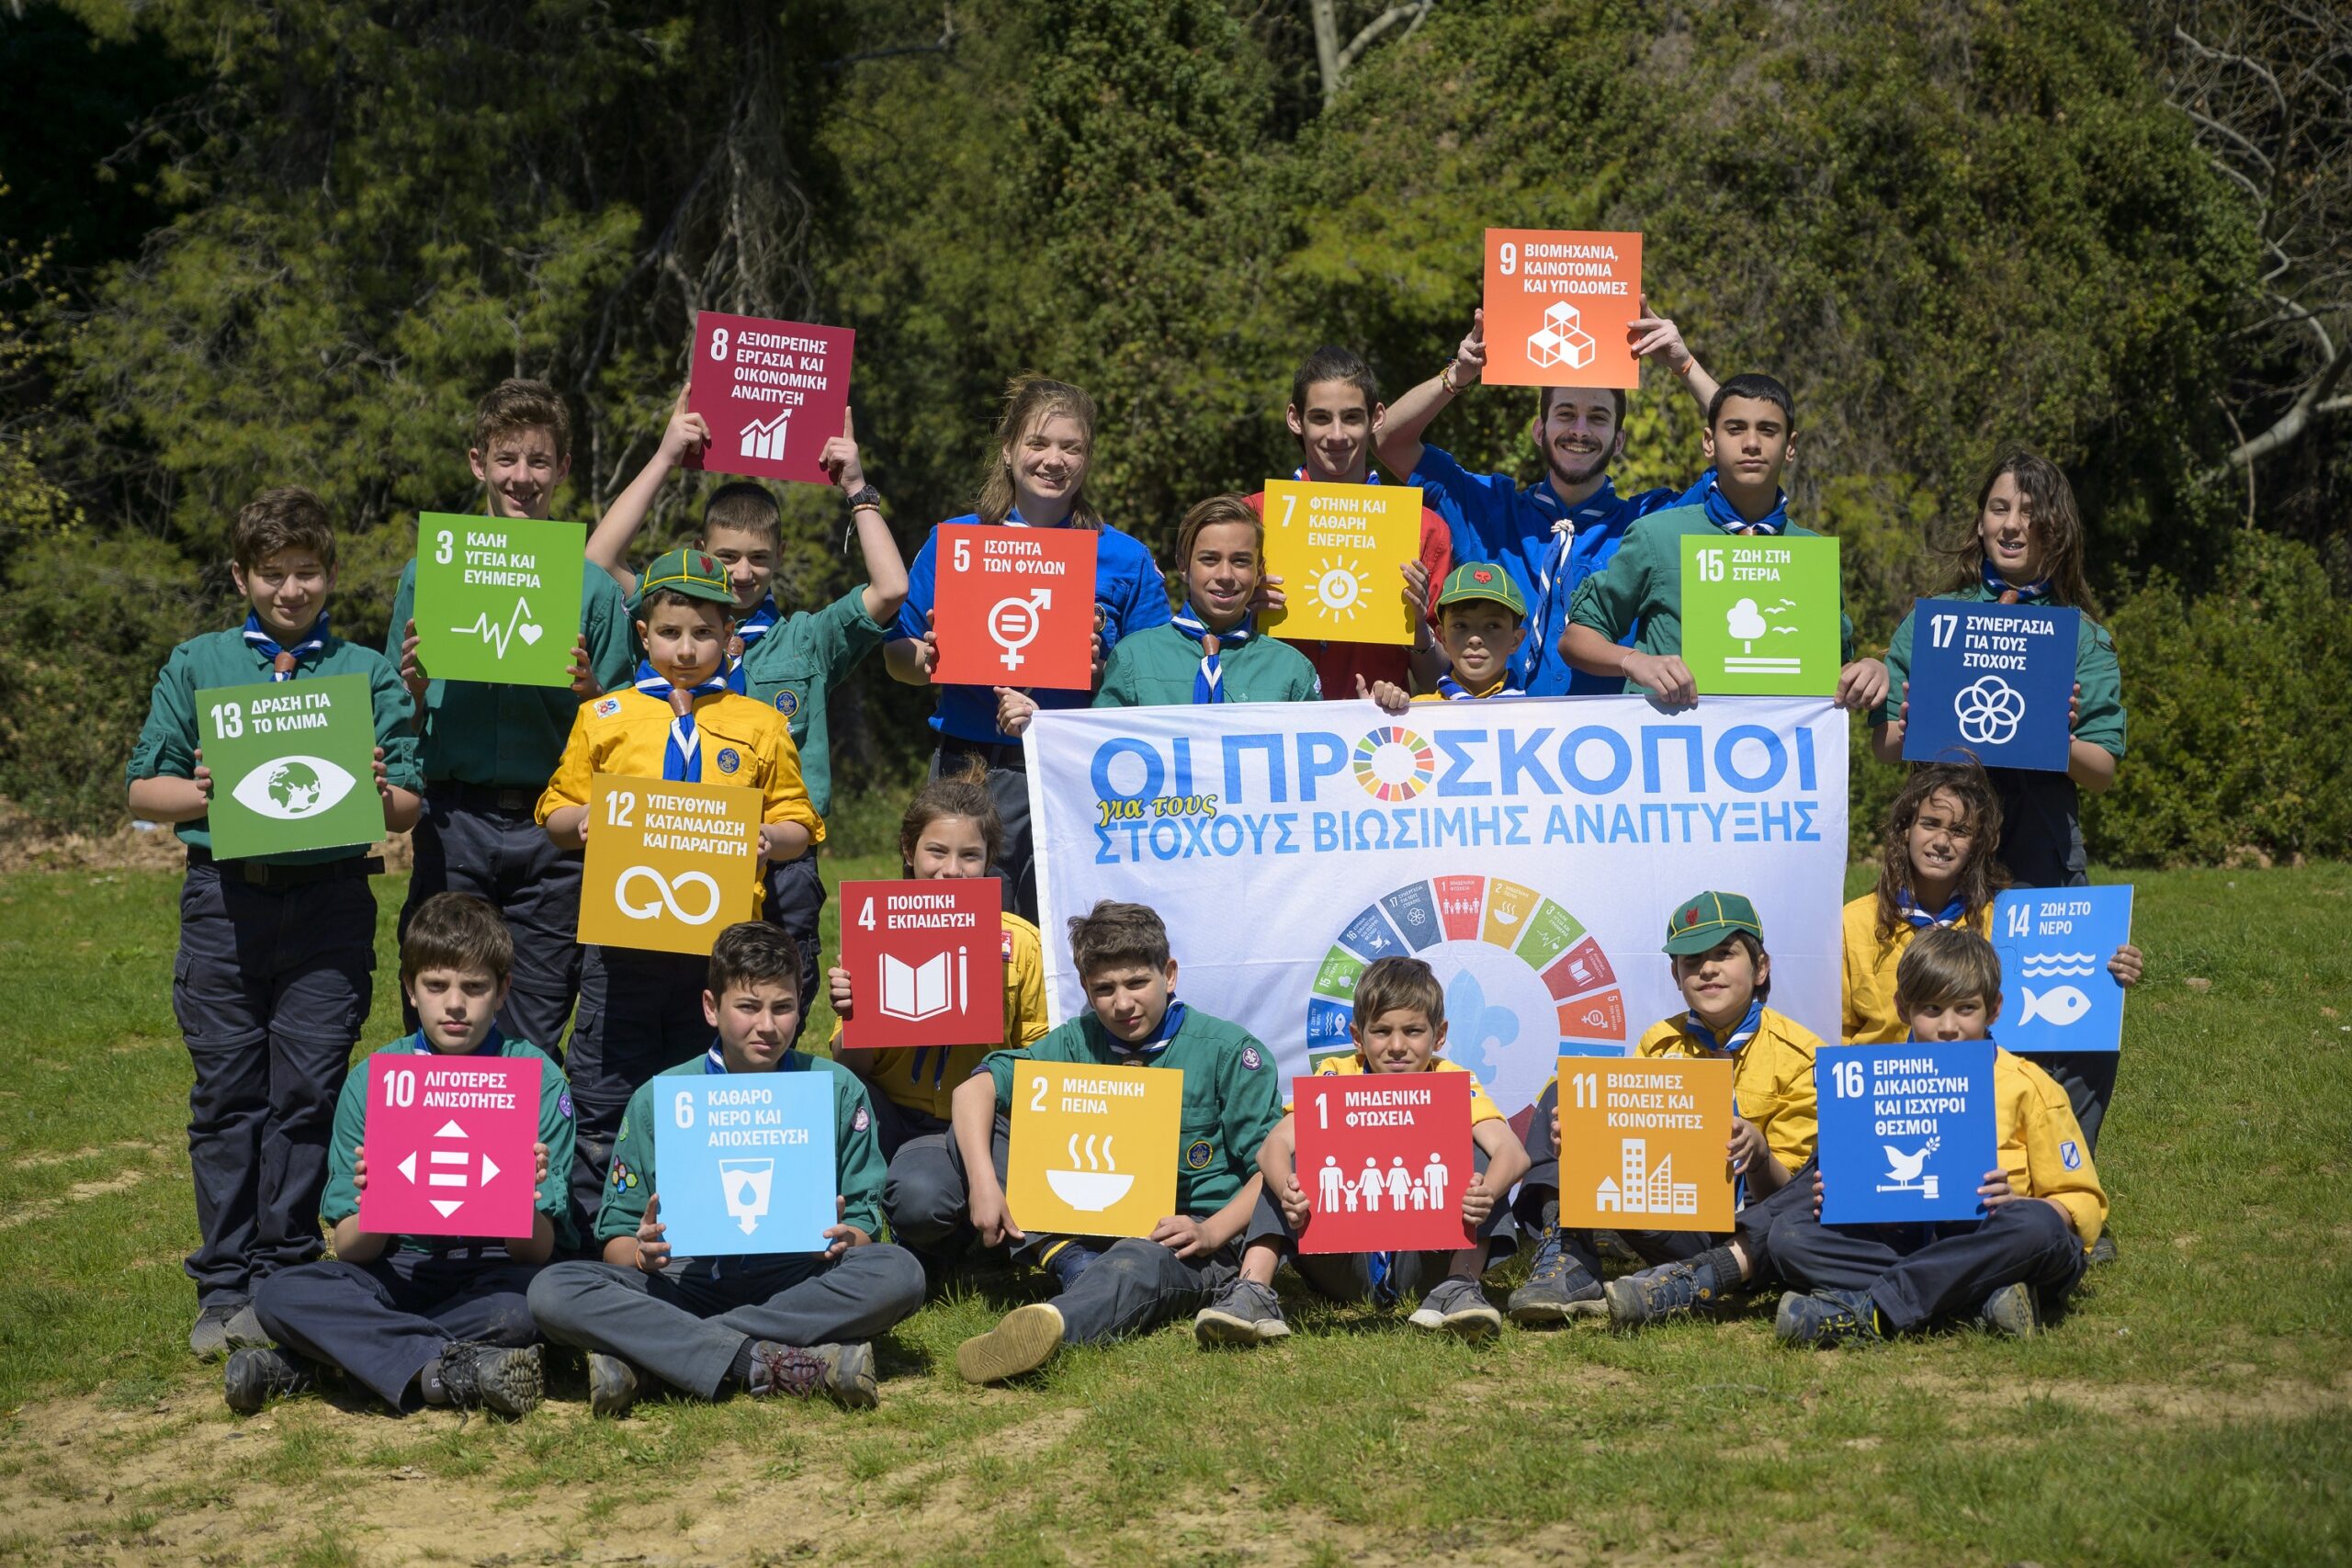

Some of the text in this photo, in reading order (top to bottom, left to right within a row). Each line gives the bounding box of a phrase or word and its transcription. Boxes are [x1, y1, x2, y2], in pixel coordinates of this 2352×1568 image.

[1499, 243, 1517, 276] 9
[1524, 243, 1619, 262] ΒΙΟΜΗΧΑΝΙΑ,
[1524, 261, 1612, 277] ΚΑΙΝΟΤΟΜΙΑ
[1523, 278, 1628, 296] ΚΑΙ ΥΠΟΔΟΜΕΣ
[710, 328, 729, 361] 8
[736, 331, 828, 355] ΑΞΙΟΠΡΕΠΗΣ
[736, 348, 824, 372] ΕΡΓΑΣΙΑ ΚΑΙ
[733, 367, 827, 391] ΟΙΚΟΝΟΜΙΚΗ
[730, 384, 804, 406] ΑΝΑΠΤΥΞΗ
[1282, 494, 1297, 527] 7
[1309, 496, 1386, 514] ΦΤΗΝΗ ΚΑΙ
[1308, 514, 1367, 531] ΚΑΘΑΡΗ
[435, 529, 454, 565] 3
[466, 531, 507, 548] ΚΑΛΗ
[984, 539, 1042, 556] ΙΣΟΤΗΤΑ
[1307, 532, 1376, 549] ΕΝΕΡΓΕΙΑ
[464, 550, 536, 570] ΥΓΕΙΑ ΚΑΙ
[954, 538, 970, 572] 5
[1732, 548, 1791, 564] ΖΩΗ ΣΤΗ
[982, 558, 1066, 575] ΤΩΝ ΦΥΛΩΝ
[1696, 548, 1724, 582] 15
[1733, 567, 1781, 581] ΣΤΕΡΙΑ
[464, 569, 541, 589] ΕΥΗΜΕΡΙΑ
[1930, 614, 1959, 649] 17
[1965, 615, 2054, 636] ΣΥΝΕΡΓΑΣΙΑ
[1964, 634, 2028, 652] ΓΙΑ ΤΟΥΣ
[1962, 652, 2027, 671] ΣΤΟΧΟΥΣ
[251, 693, 332, 715] ΔΡΑΣΗ ΓΙΑ
[210, 702, 243, 739] 13
[252, 712, 328, 734] ΤΟ ΚΛΙΜΑ
[1091, 724, 1817, 810] ΟΙ ΠΡΟΣΚΟΠΟΙ
[605, 790, 636, 828] 12
[646, 794, 727, 816] ΥΠΕΥΘΥΝΗ
[1097, 794, 1218, 829] για τους
[645, 813, 745, 837] ΚΑΤΑΝΑΛΩΣΗ
[1093, 800, 1821, 865] ΣΤΟΧΟΥΣ ΒΙΩΣΙΜΗΣ ΑΝΑΠΤΥΞΗΣ
[643, 832, 748, 857] ΚΑΙ ΠΑΡΑΓΩΓΗ
[1441, 882, 1446, 892] 1
[1495, 883, 1503, 893] 2
[888, 894, 956, 910] ΠΟΙΟΤΙΚΗ
[1389, 897, 1398, 908] 17
[1545, 906, 1555, 915] 3
[2040, 901, 2091, 917] ΖΩΗ ΣΤΟ
[857, 897, 876, 931] 4
[888, 912, 976, 930] ΕΚΠΑΙΔΕΥΣΗ
[2007, 904, 2030, 938] 14
[1346, 930, 1358, 942] 16
[2039, 920, 2073, 935] ΝΕΡΟ
[1319, 976, 1331, 987] 15
[1310, 1028, 1320, 1037] 14
[1873, 1057, 1939, 1076] ΕΙΡΗΝΗ,
[383, 1069, 415, 1108] 10
[424, 1071, 507, 1089] ΛΙΓΟΤΕΡΕΣ
[1062, 1077, 1145, 1097] ΜΗΔΕΝΙΚΗ
[1607, 1073, 1683, 1089] ΒΙΩΣΙΜΕΣ
[1832, 1060, 1865, 1099] 16
[1872, 1077, 1969, 1096] ΔΙΚΑΙΟΣΥΝΗ
[707, 1089, 773, 1106] ΚΑΘΑΡΟ
[1030, 1076, 1048, 1112] 2
[1345, 1089, 1431, 1107] ΜΗΔΕΝΙΚΗ
[1572, 1072, 1598, 1109] 11
[423, 1091, 516, 1110] ΑΝΙΣΟΤΗΤΕΣ
[675, 1090, 695, 1129] 6
[1061, 1097, 1108, 1114] ΠΕΙΝΑ
[1607, 1092, 1694, 1110] ΠΟΛΕΙΣ ΚΑΙ
[1874, 1097, 1965, 1116] ΚΑΙ ΙΣΧΥΡΟΙ
[708, 1109, 781, 1126] ΝΕΡΟ ΚΑΙ
[1315, 1092, 1329, 1130] 1
[1345, 1110, 1415, 1128] ΦΤΩΧΕΙΑ
[1607, 1112, 1703, 1130] ΚΟΙΝΟΤΗΤΕΣ
[1874, 1118, 1938, 1136] ΘΕΣΜΟΙ
[707, 1129, 808, 1147] ΑΠΟΧΕΤΕΥΣΗ
